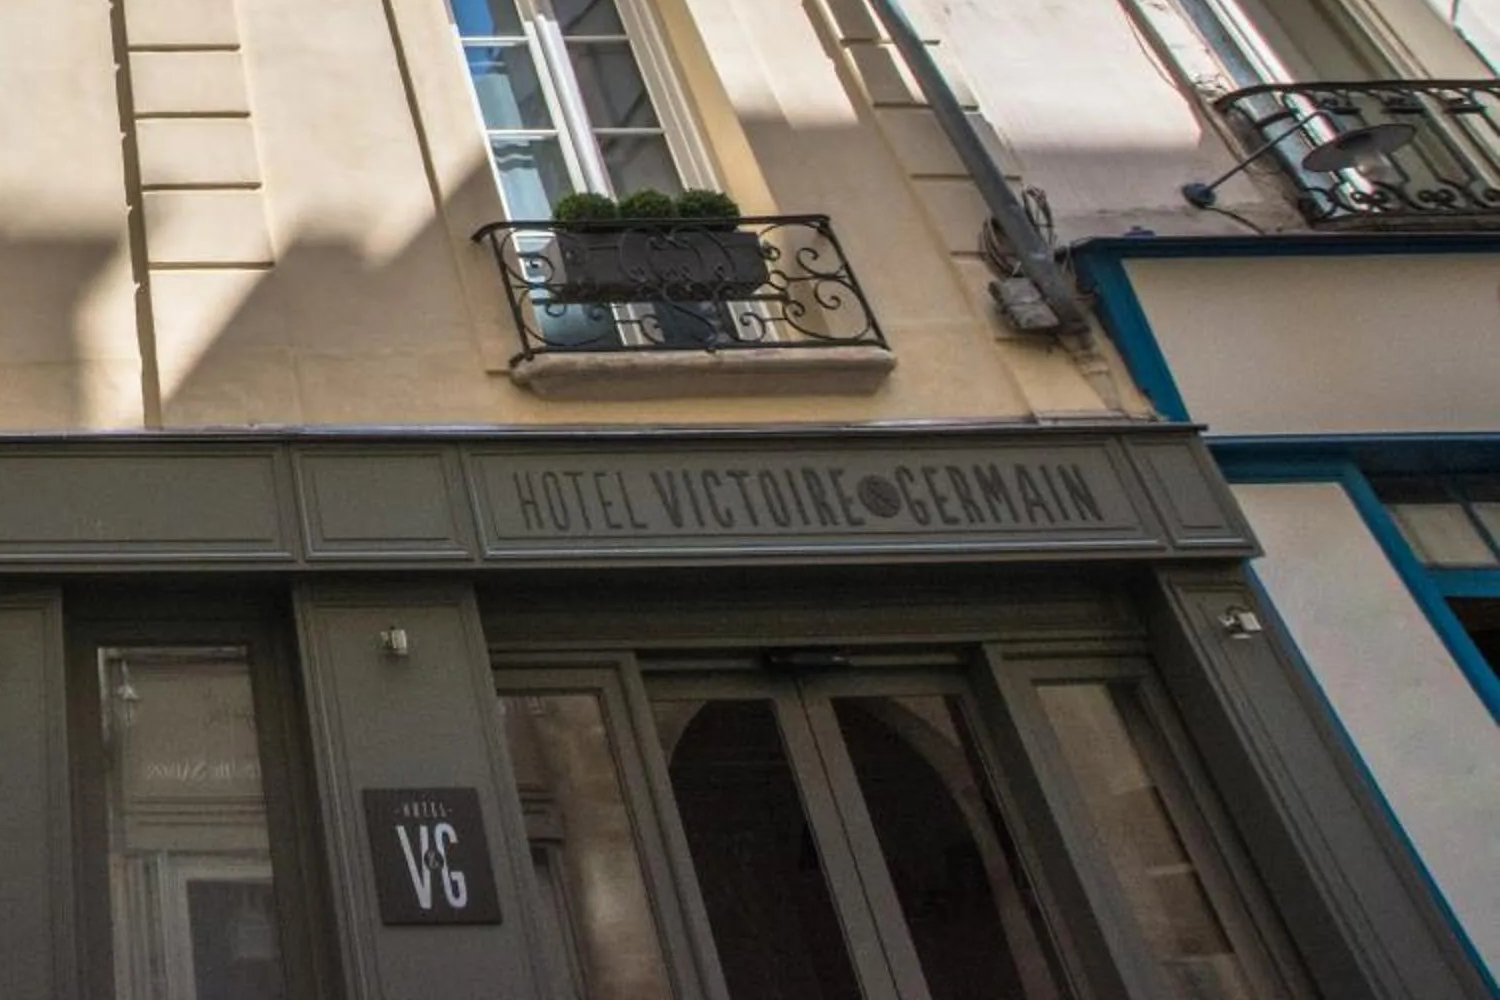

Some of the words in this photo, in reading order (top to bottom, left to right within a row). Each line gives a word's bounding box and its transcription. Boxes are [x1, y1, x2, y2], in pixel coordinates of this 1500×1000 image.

[513, 468, 648, 531] HOTEL
[650, 467, 865, 529] VICTOIRE
[894, 463, 1104, 525] GERMAIN
